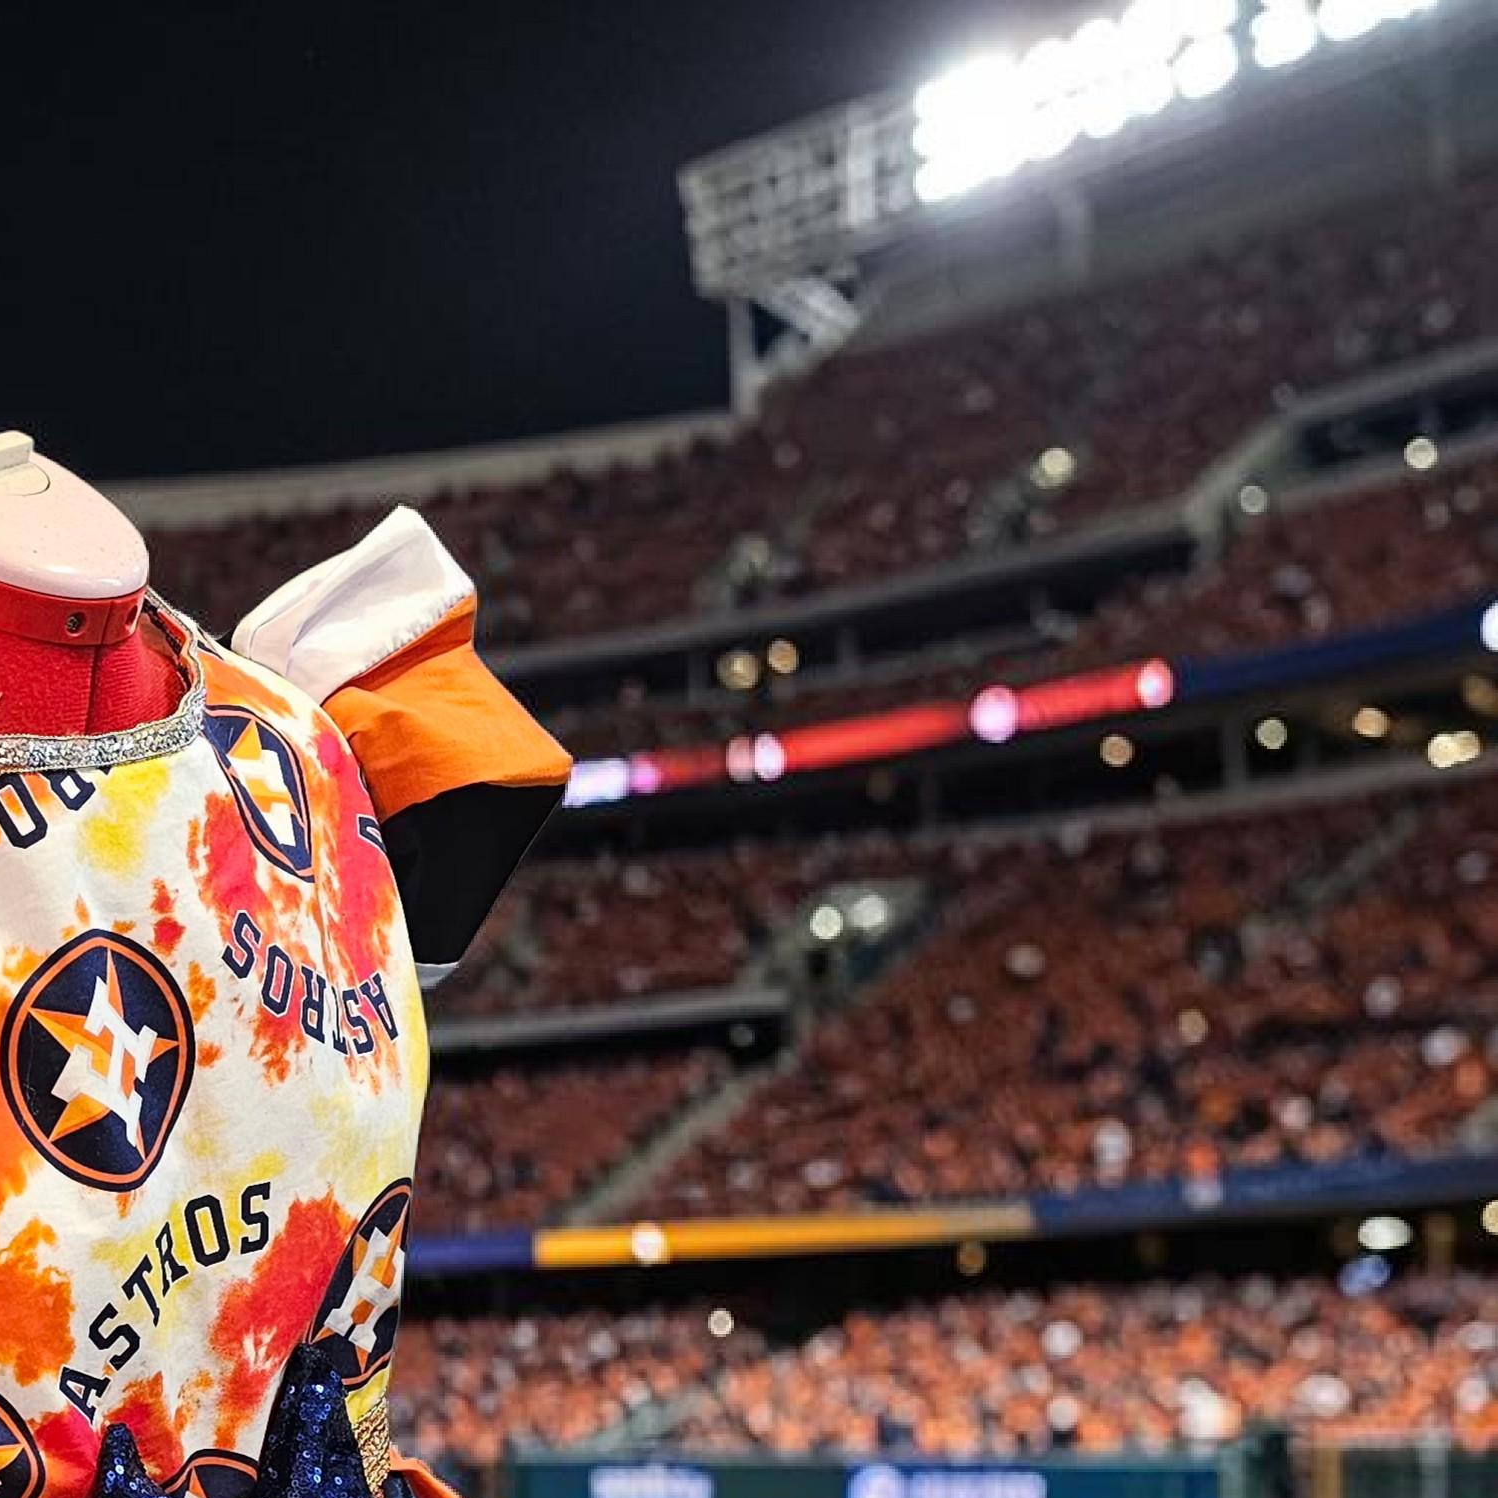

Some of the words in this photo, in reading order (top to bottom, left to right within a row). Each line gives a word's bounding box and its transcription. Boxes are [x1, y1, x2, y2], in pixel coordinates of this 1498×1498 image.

[51, 975, 158, 1148] H
[221, 910, 399, 1056] ASTROS
[59, 1181, 271, 1422] ASTROS
[324, 1226, 406, 1353] H
